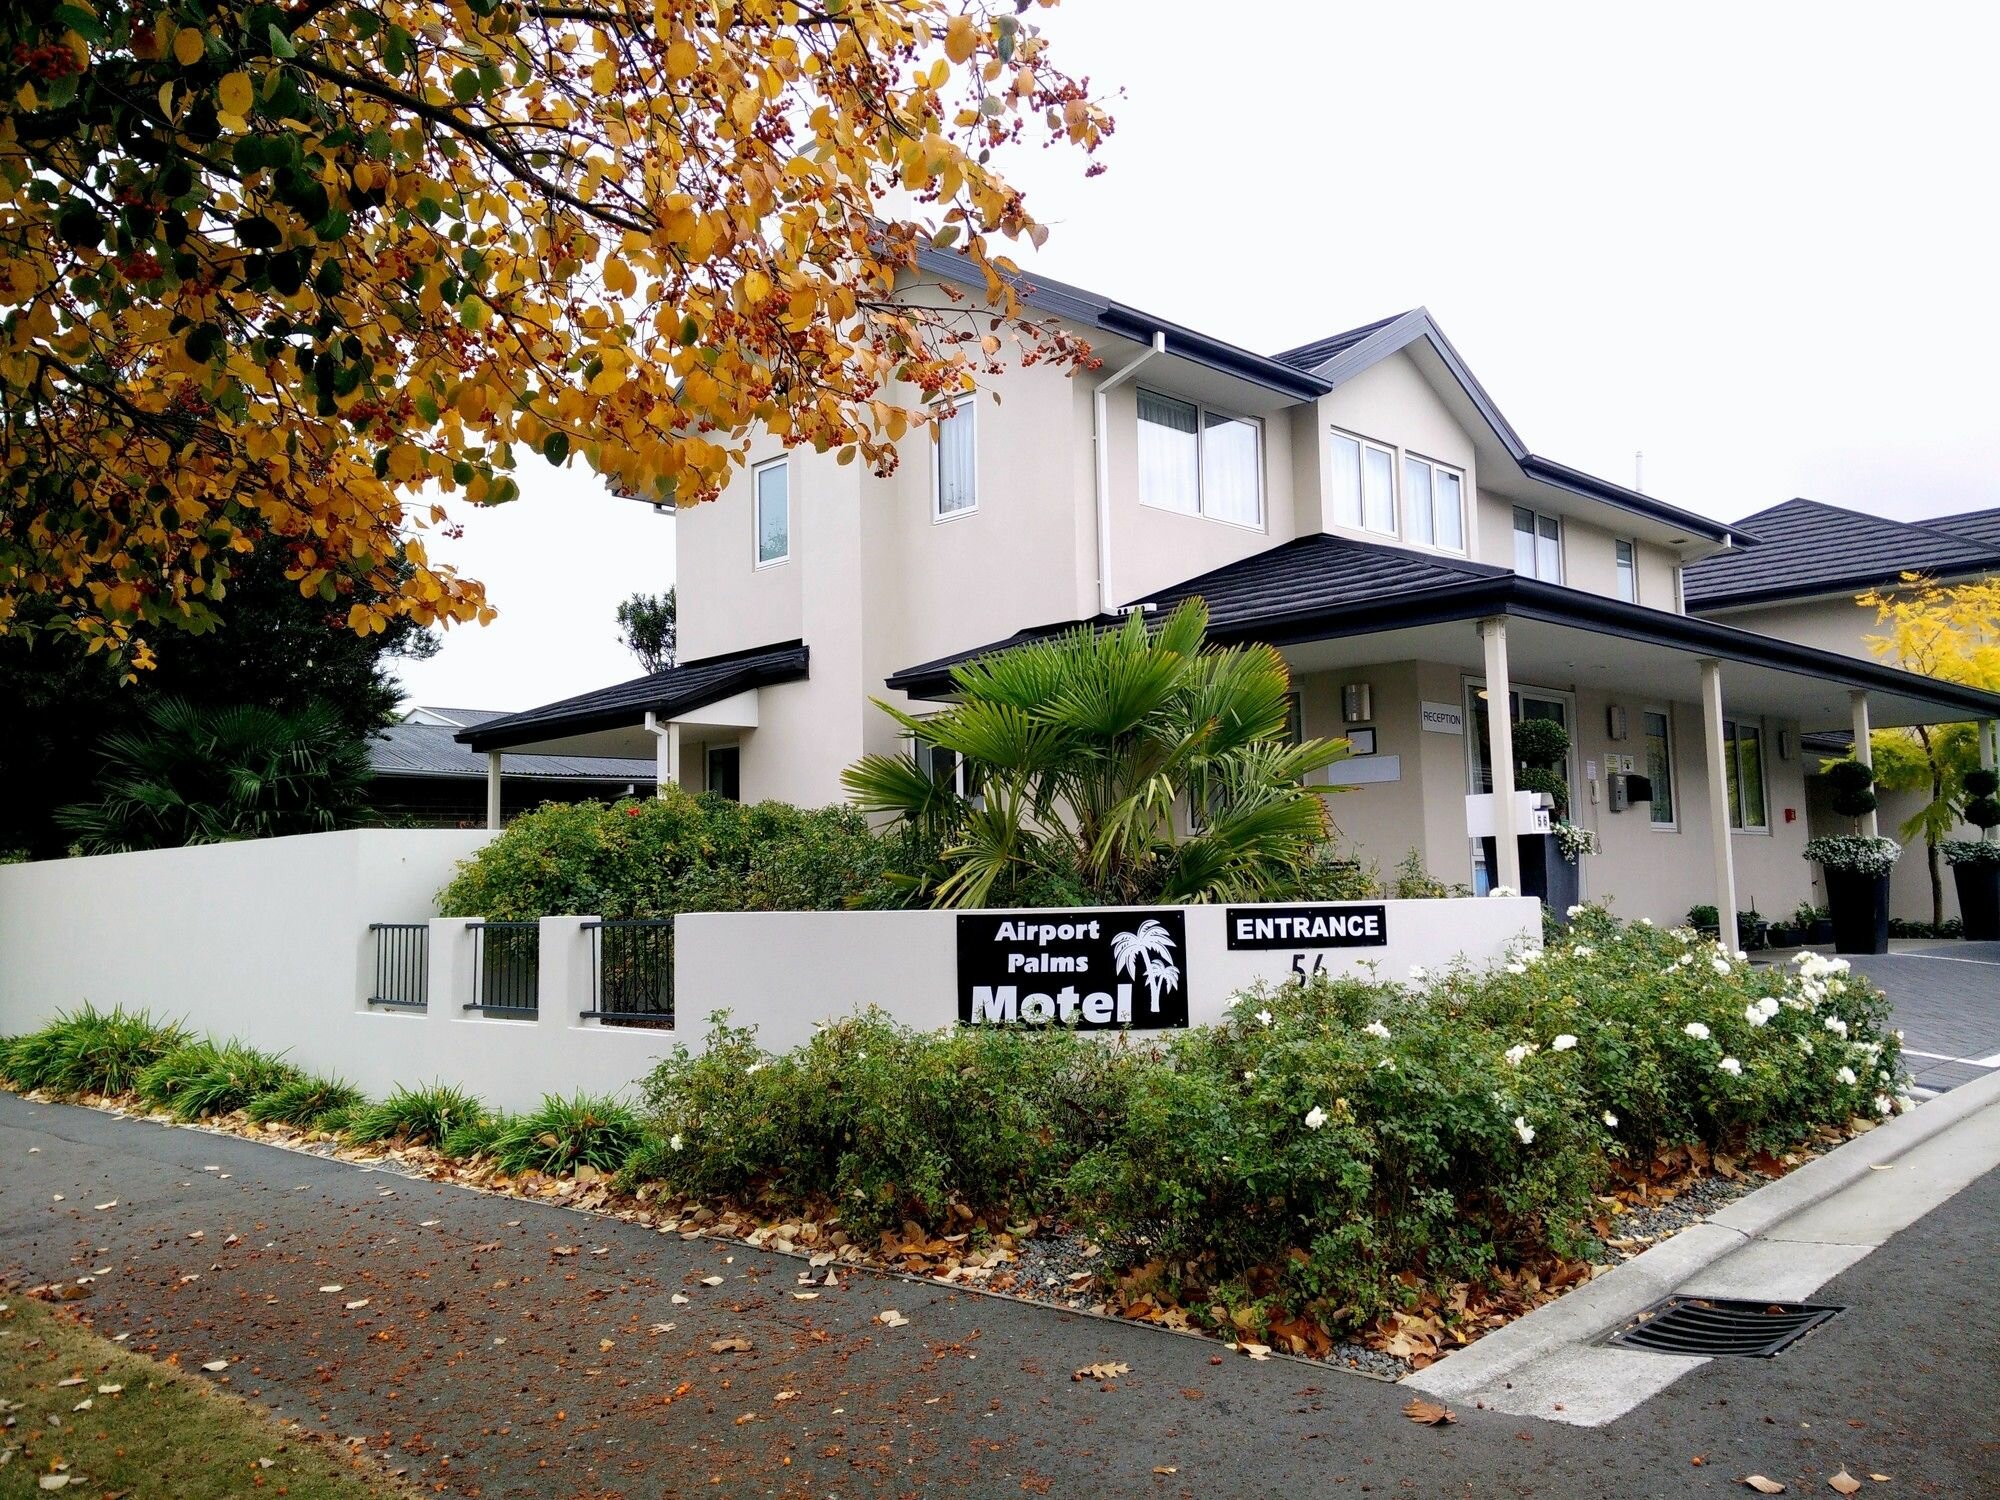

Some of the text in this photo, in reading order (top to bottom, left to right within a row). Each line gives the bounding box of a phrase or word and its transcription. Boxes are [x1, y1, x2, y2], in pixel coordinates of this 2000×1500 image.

[1423, 710, 1461, 725] RECEPTION
[1537, 815, 1548, 828] 56
[994, 920, 1100, 946] Airport
[1236, 915, 1379, 940] ENTRANCE
[1008, 953, 1089, 973] Palms
[971, 983, 1133, 1024] Motel
